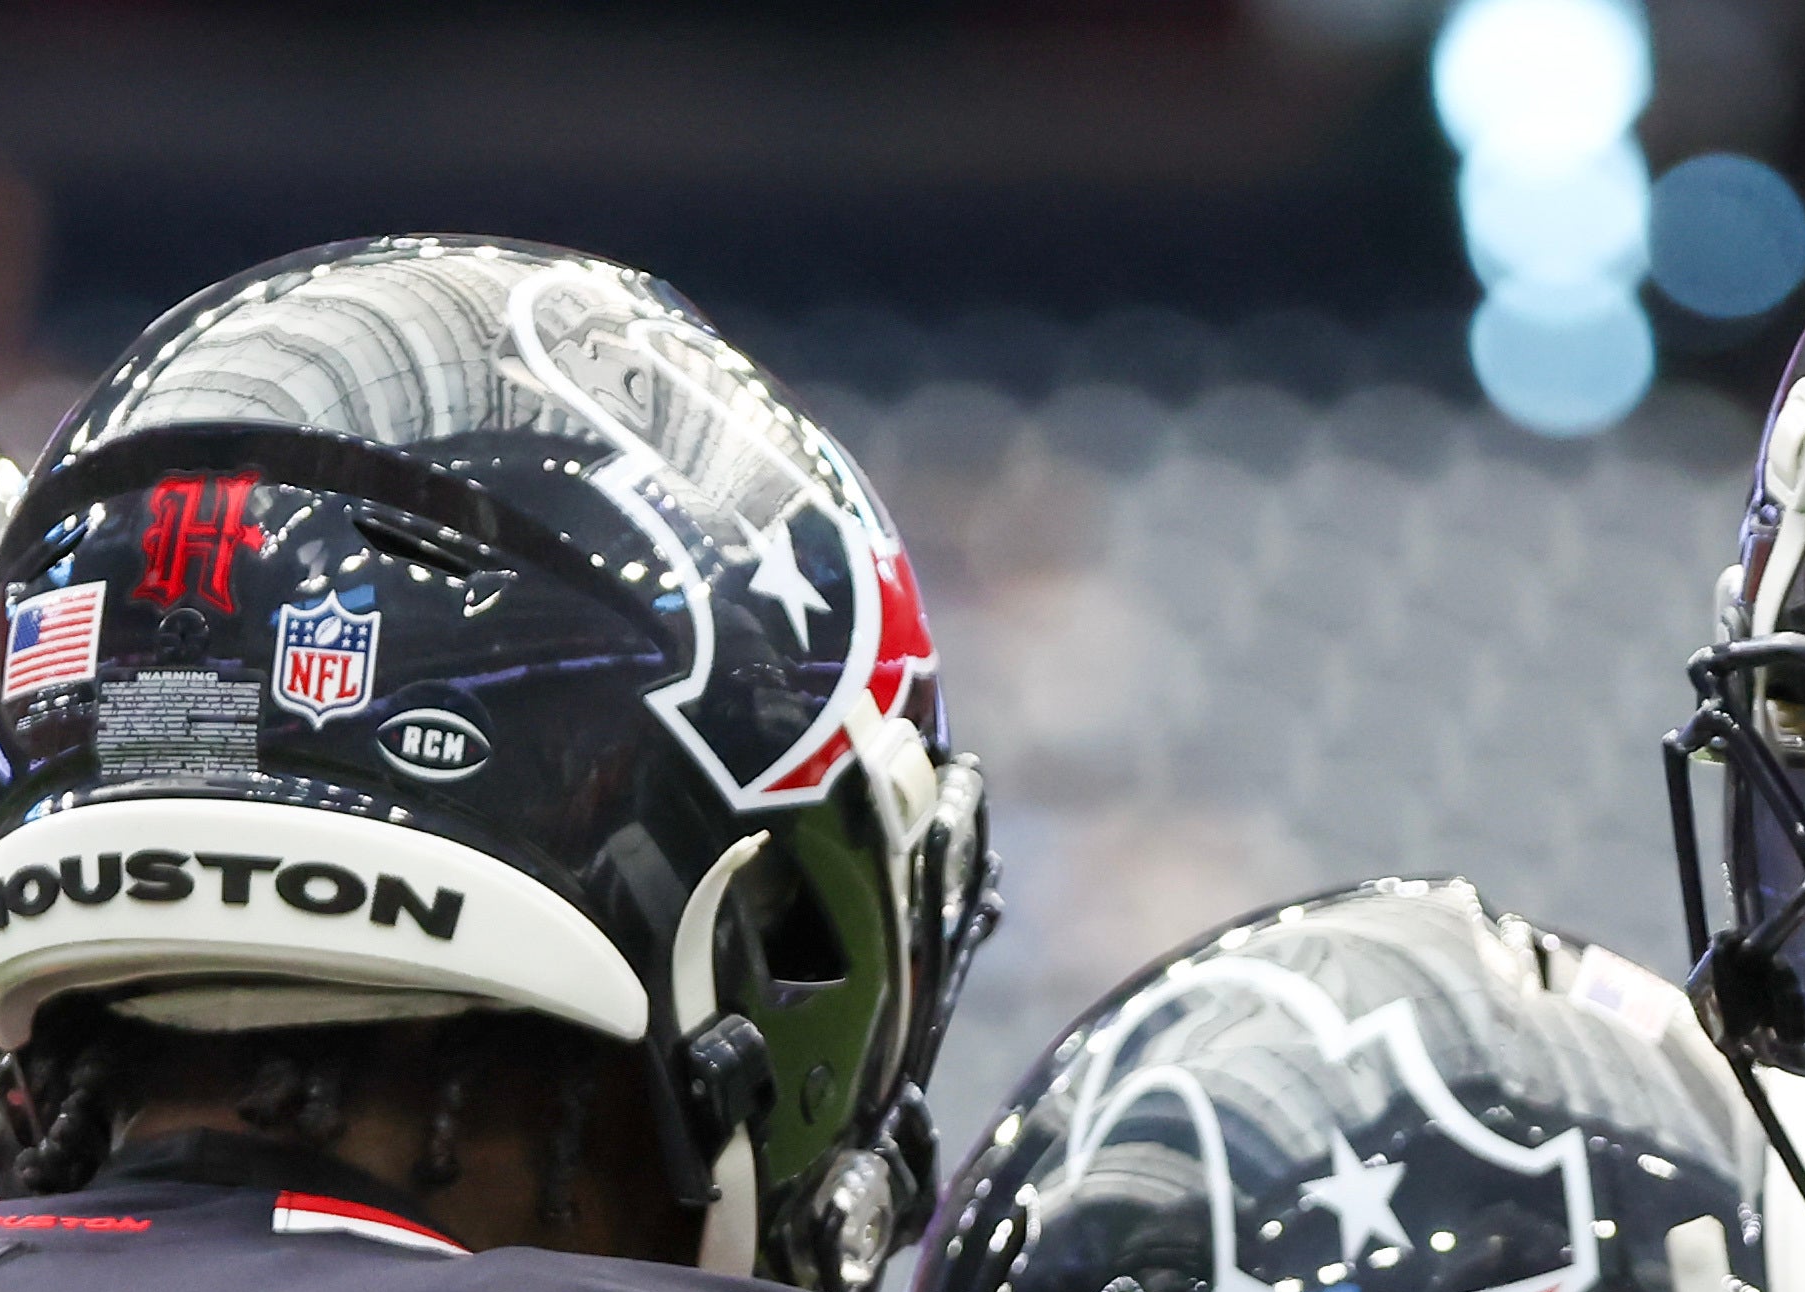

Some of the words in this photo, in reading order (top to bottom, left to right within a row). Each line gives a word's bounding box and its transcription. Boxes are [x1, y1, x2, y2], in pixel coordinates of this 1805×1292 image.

[137, 671, 219, 681] WARNING
[287, 651, 358, 704] NFL
[401, 725, 466, 762] RCM
